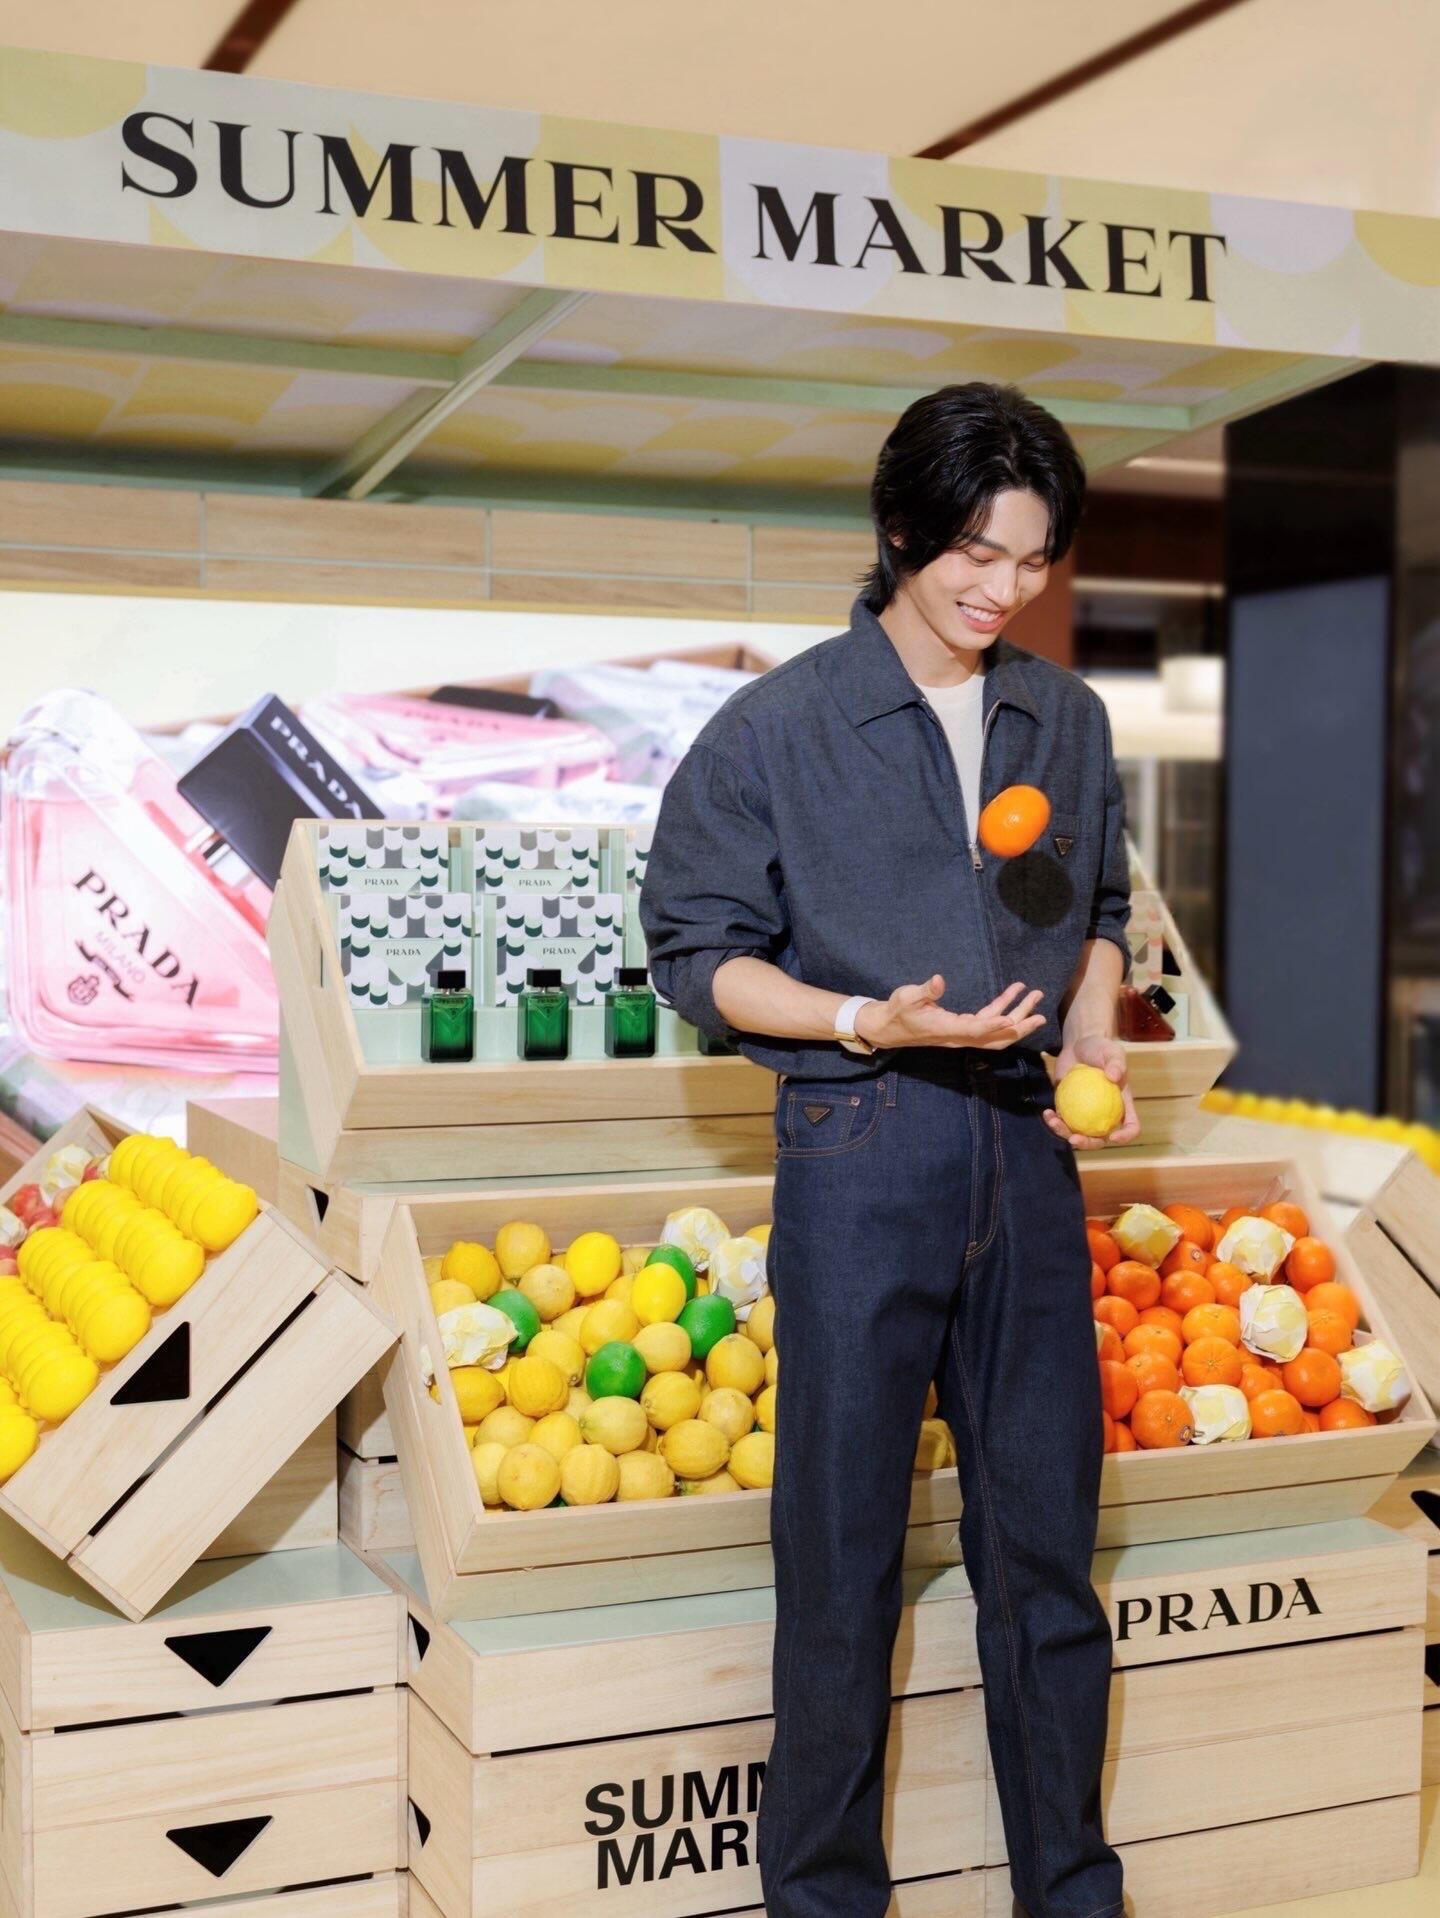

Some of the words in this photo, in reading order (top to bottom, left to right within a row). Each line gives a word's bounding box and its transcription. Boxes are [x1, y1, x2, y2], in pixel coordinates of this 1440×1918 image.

[121, 111, 717, 254] SUMMER
[752, 184, 1227, 303] MARKET
[270, 715, 363, 819] PRADA
[364, 878, 399, 887] PRADA
[518, 879, 552, 887] PRADA
[74, 869, 198, 1007] PRADA
[95, 931, 146, 984] MILANO
[386, 948, 421, 956] PRADA
[542, 947, 577, 955] PRADA
[1114, 1577, 1323, 1642] PRADA
[597, 1816, 761, 1890] MAR
